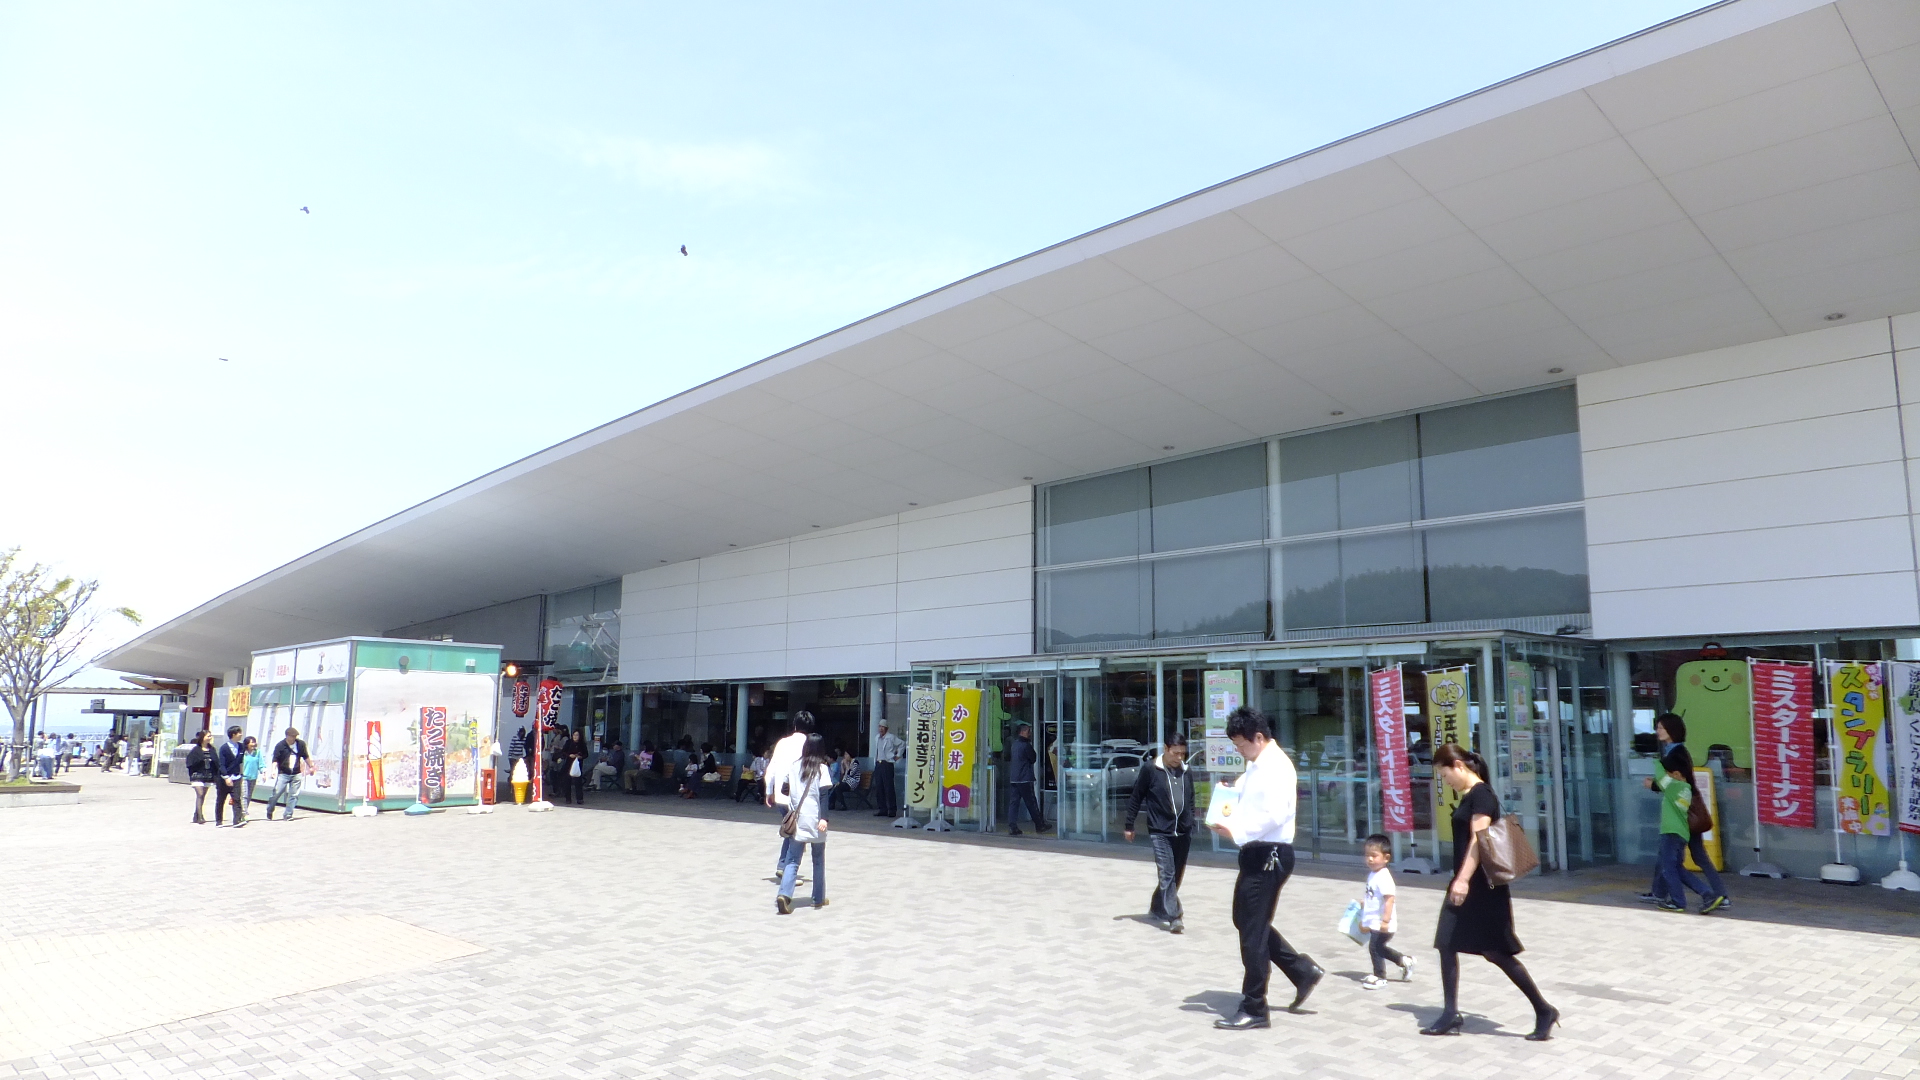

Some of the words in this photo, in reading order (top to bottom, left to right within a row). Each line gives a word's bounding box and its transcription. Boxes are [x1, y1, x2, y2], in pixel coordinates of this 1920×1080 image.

[424, 708, 445, 788] たこ焼き
[913, 719, 930, 804] 玉ねぎラーメン
[949, 704, 969, 770] かつ丼
[1771, 670, 1800, 817] ミスタードーナツ
[1840, 666, 1875, 815] スタンプラリー
